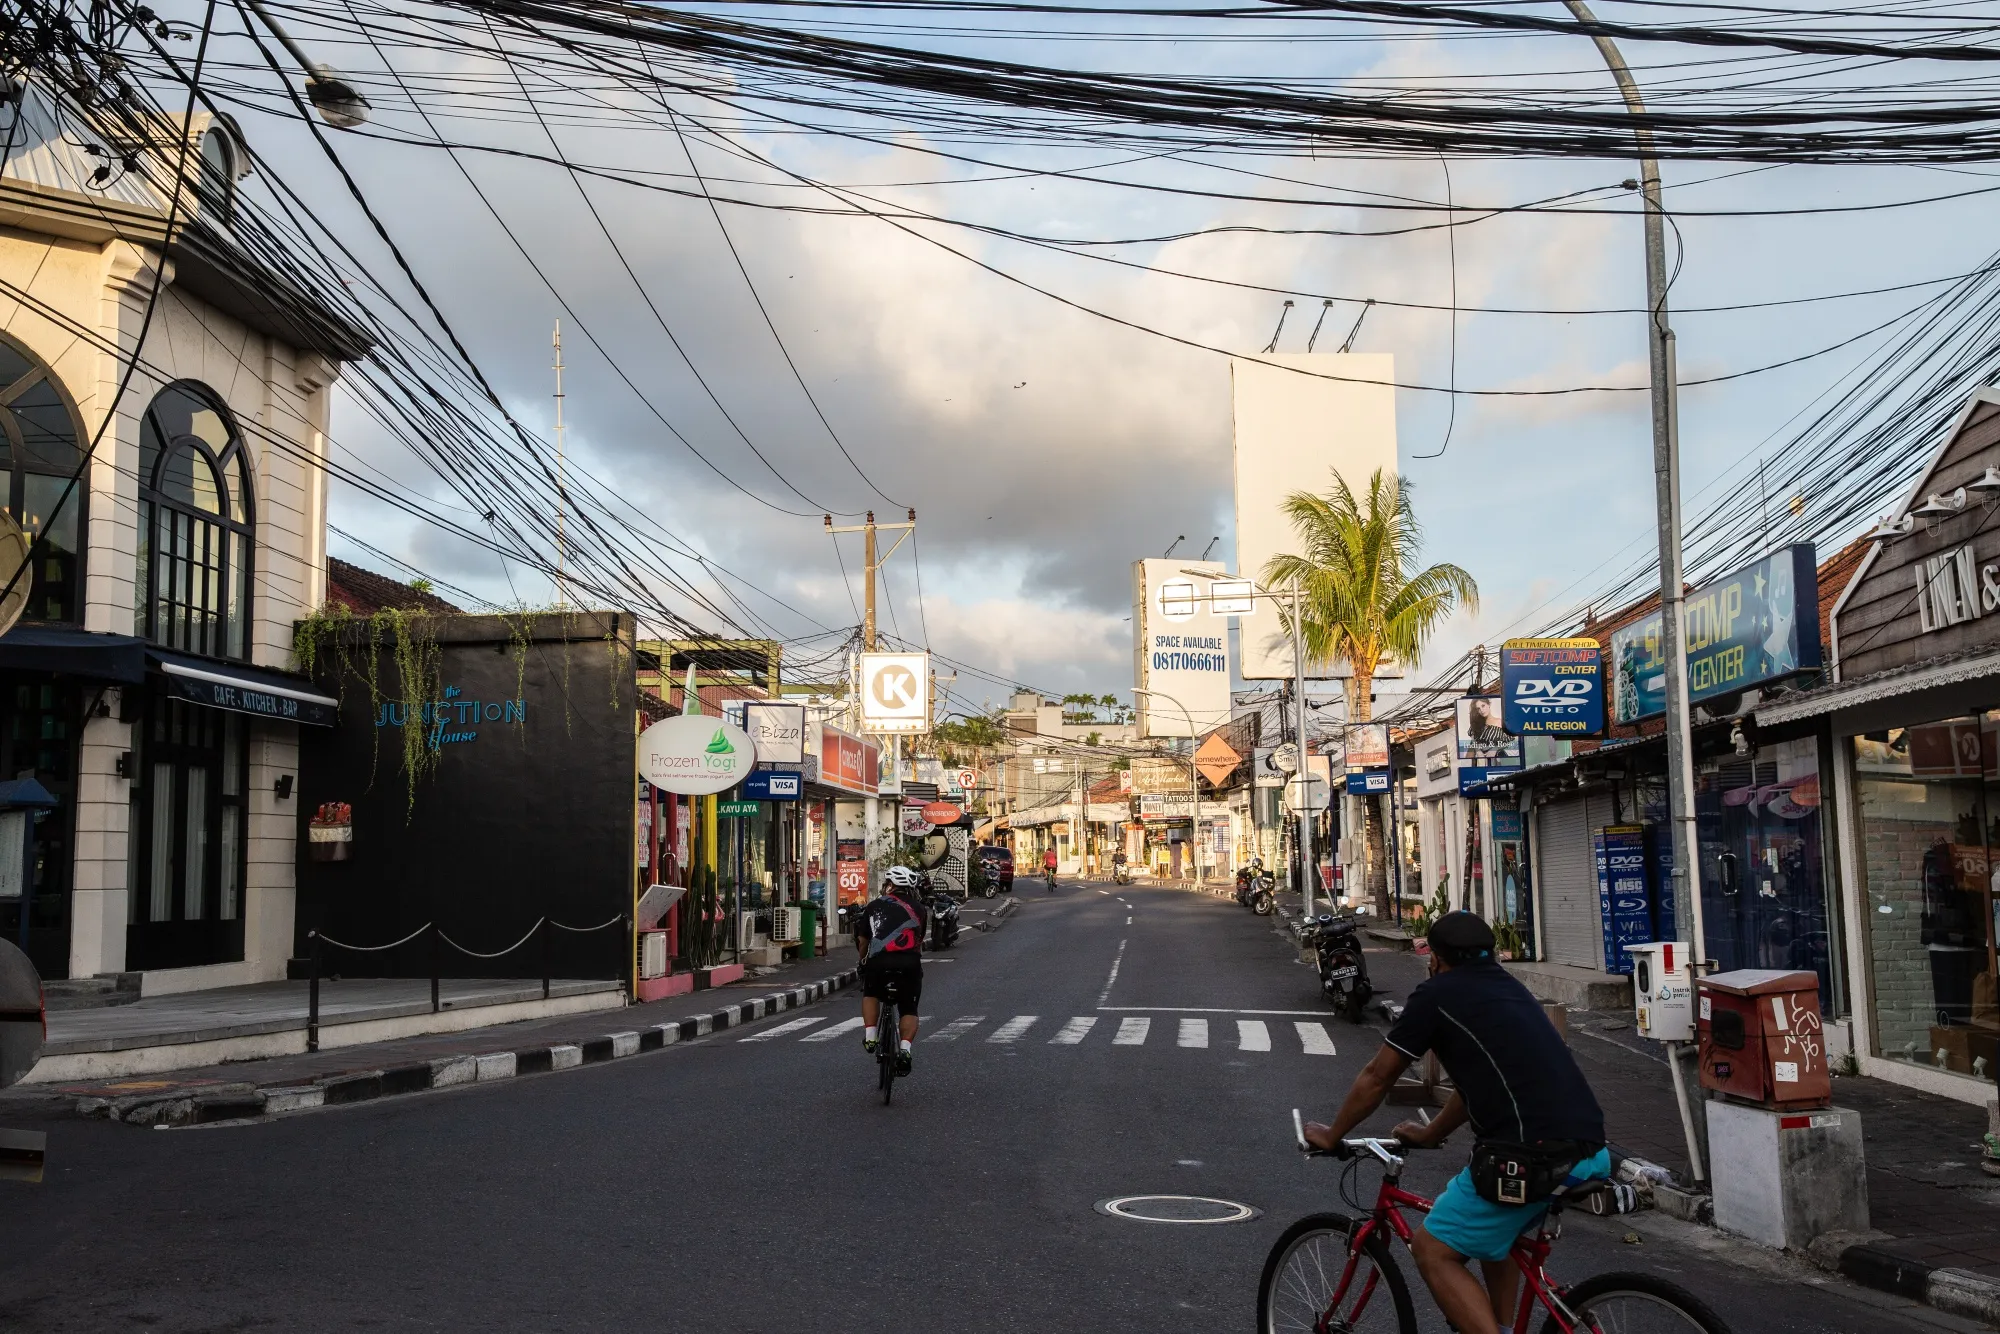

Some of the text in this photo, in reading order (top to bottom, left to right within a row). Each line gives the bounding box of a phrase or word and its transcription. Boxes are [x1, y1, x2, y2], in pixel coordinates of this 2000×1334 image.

[1915, 546, 1981, 633] LINEN
[1155, 635, 1222, 650] SPACE AVAILABLE
[1153, 652, 1225, 672] 08170666111
[1510, 650, 1597, 663] SOFTCOMP
[1555, 665, 1597, 674] CENTER
[1693, 645, 1744, 692] CENTER
[445, 685, 461, 698] the
[884, 673, 914, 709] K
[1516, 679, 1592, 698] DVD
[214, 685, 235, 704] CAFE
[242, 691, 277, 714] KITCHEN
[283, 701, 298, 717] BAR
[375, 700, 526, 727] JUNCTION
[1521, 706, 1579, 714] VIDEO
[1523, 721, 1587, 730] ALL REGION
[428, 721, 477, 751] House
[1463, 742, 1487, 750] Indigo
[650, 753, 737, 772] Frozen Yogi
[842, 749, 857, 771] CIRCLE
[1195, 755, 1237, 763] somewhere
[774, 781, 794, 789] VISA
[743, 804, 757, 813] AYA
[1144, 802, 1161, 812] MONEY
[1610, 856, 1644, 865] DVD
[840, 873, 866, 888] 60%
[1614, 879, 1643, 892] disc
